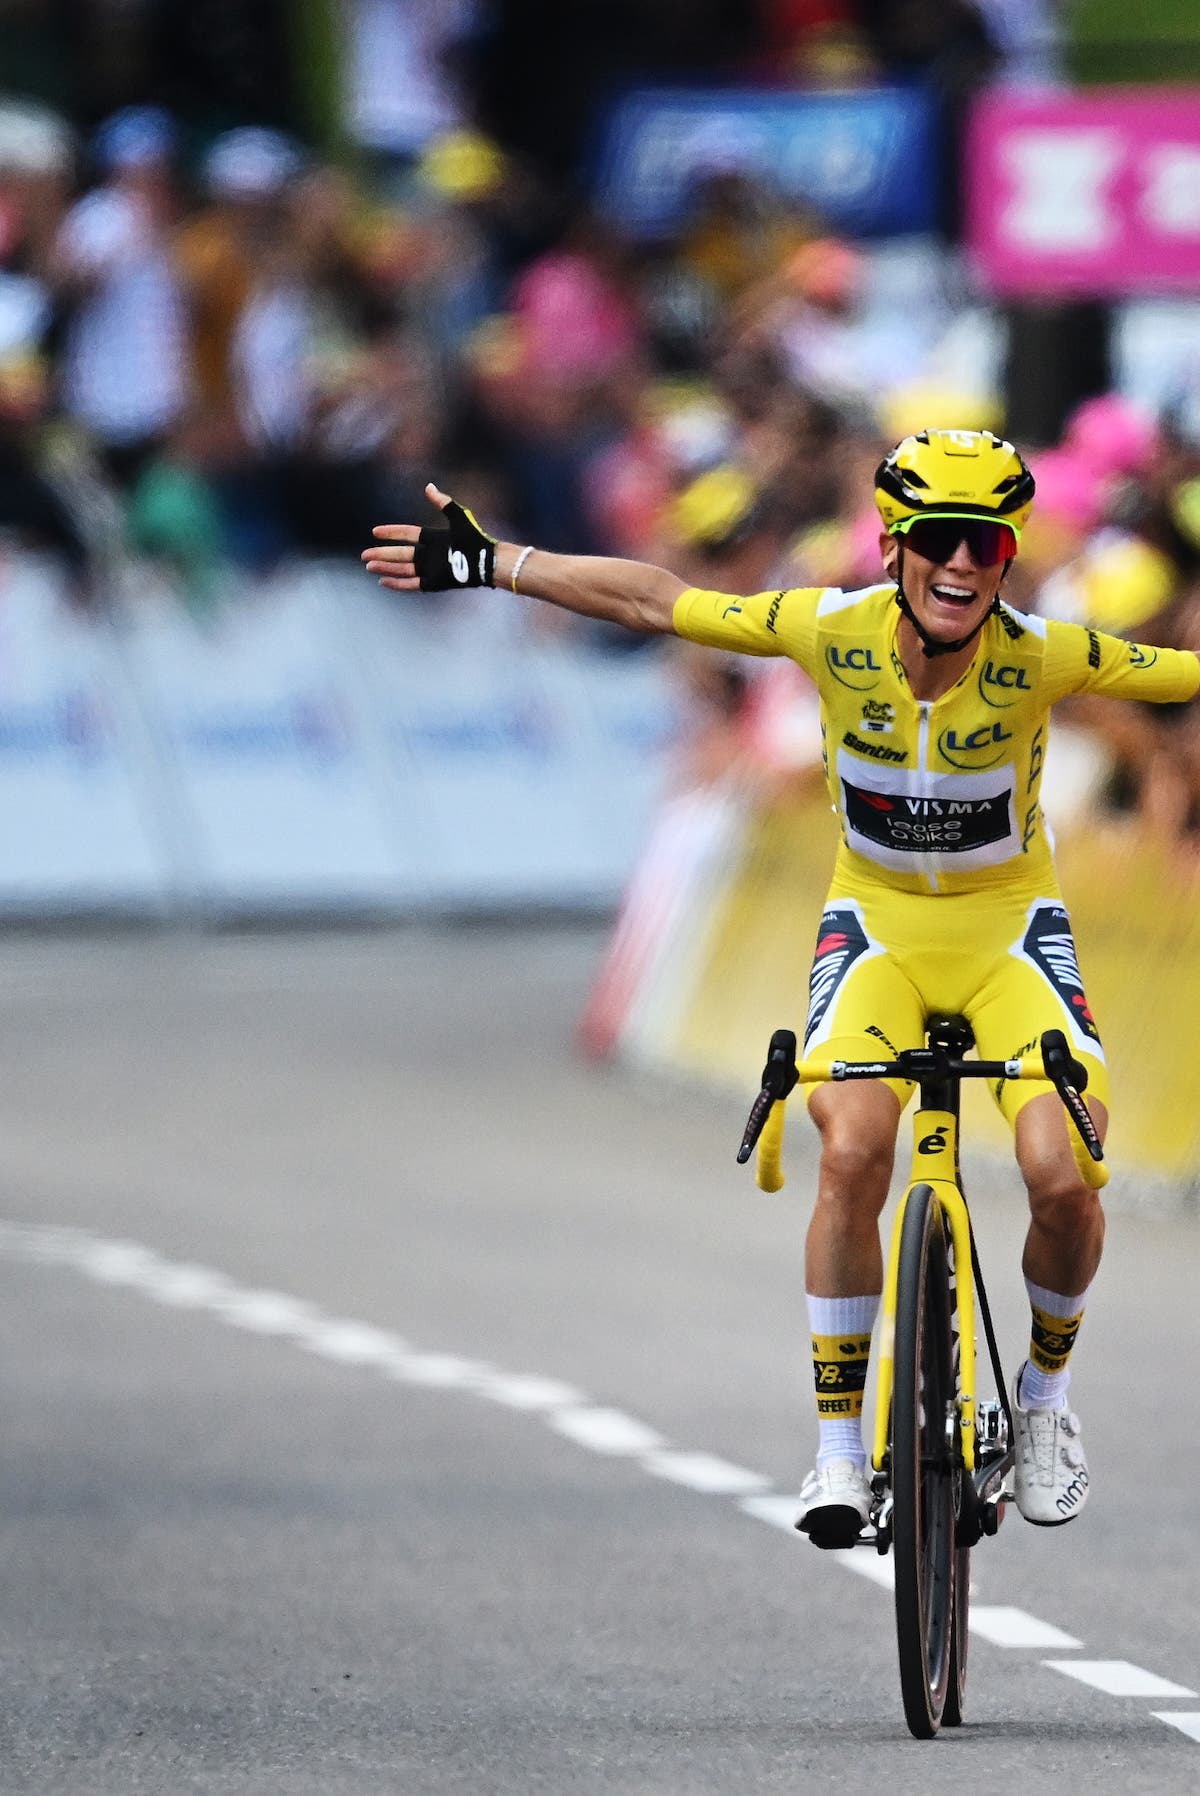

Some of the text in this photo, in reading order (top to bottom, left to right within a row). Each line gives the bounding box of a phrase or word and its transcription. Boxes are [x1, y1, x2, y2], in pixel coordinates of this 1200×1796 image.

[830, 647, 882, 671] LCL
[984, 661, 1032, 690] LCL
[842, 731, 909, 763] Santini
[946, 721, 1013, 751] LCL
[905, 799, 992, 816] VISMA
[886, 817, 963, 833] lease
